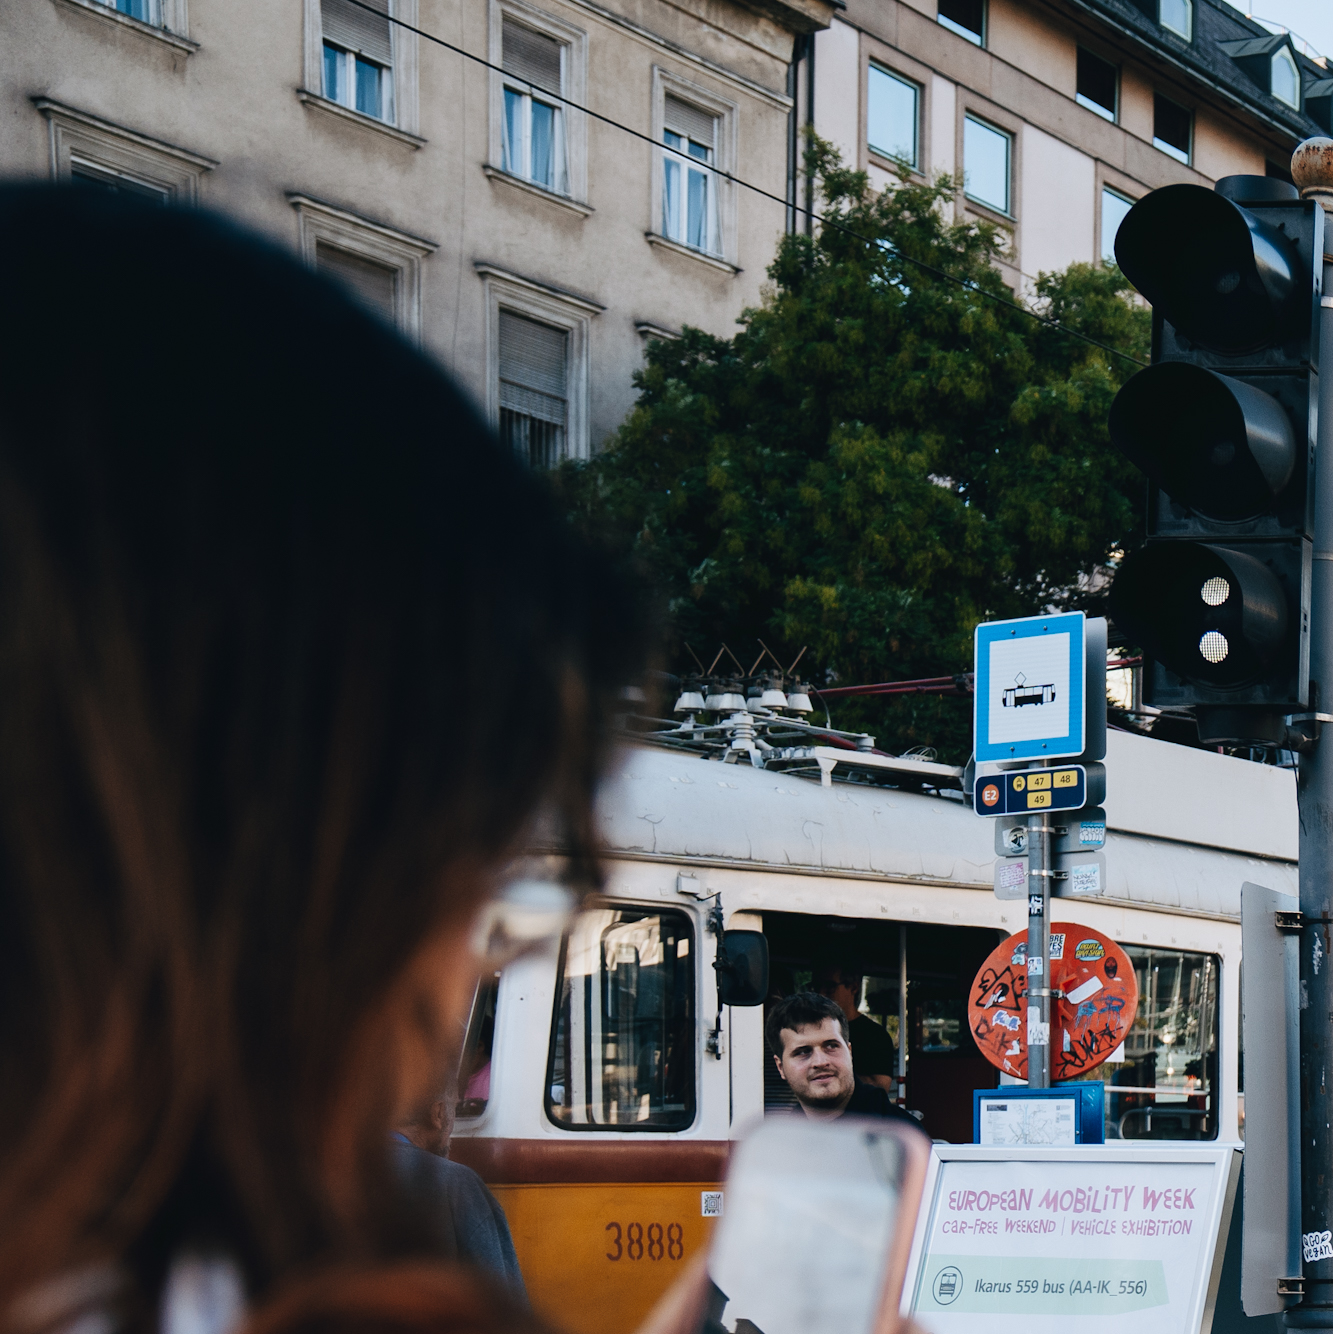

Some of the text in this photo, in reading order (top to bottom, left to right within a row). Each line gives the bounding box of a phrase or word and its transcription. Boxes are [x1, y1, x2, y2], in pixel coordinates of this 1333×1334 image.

[1034, 774, 1071, 787] 47 48
[984, 789, 997, 801] E2
[1034, 794, 1044, 804] 49
[1143, 1186, 1197, 1212] WEEK
[1004, 1217, 1057, 1235] WEEKEND
[1070, 1218, 1117, 1236] VEHICLE
[1121, 1218, 1193, 1237] EXHIBITION
[605, 1221, 684, 1262] 3888
[974, 1278, 1012, 1294] Ikarus
[1015, 1280, 1039, 1294] 559
[1043, 1279, 1065, 1294] bus
